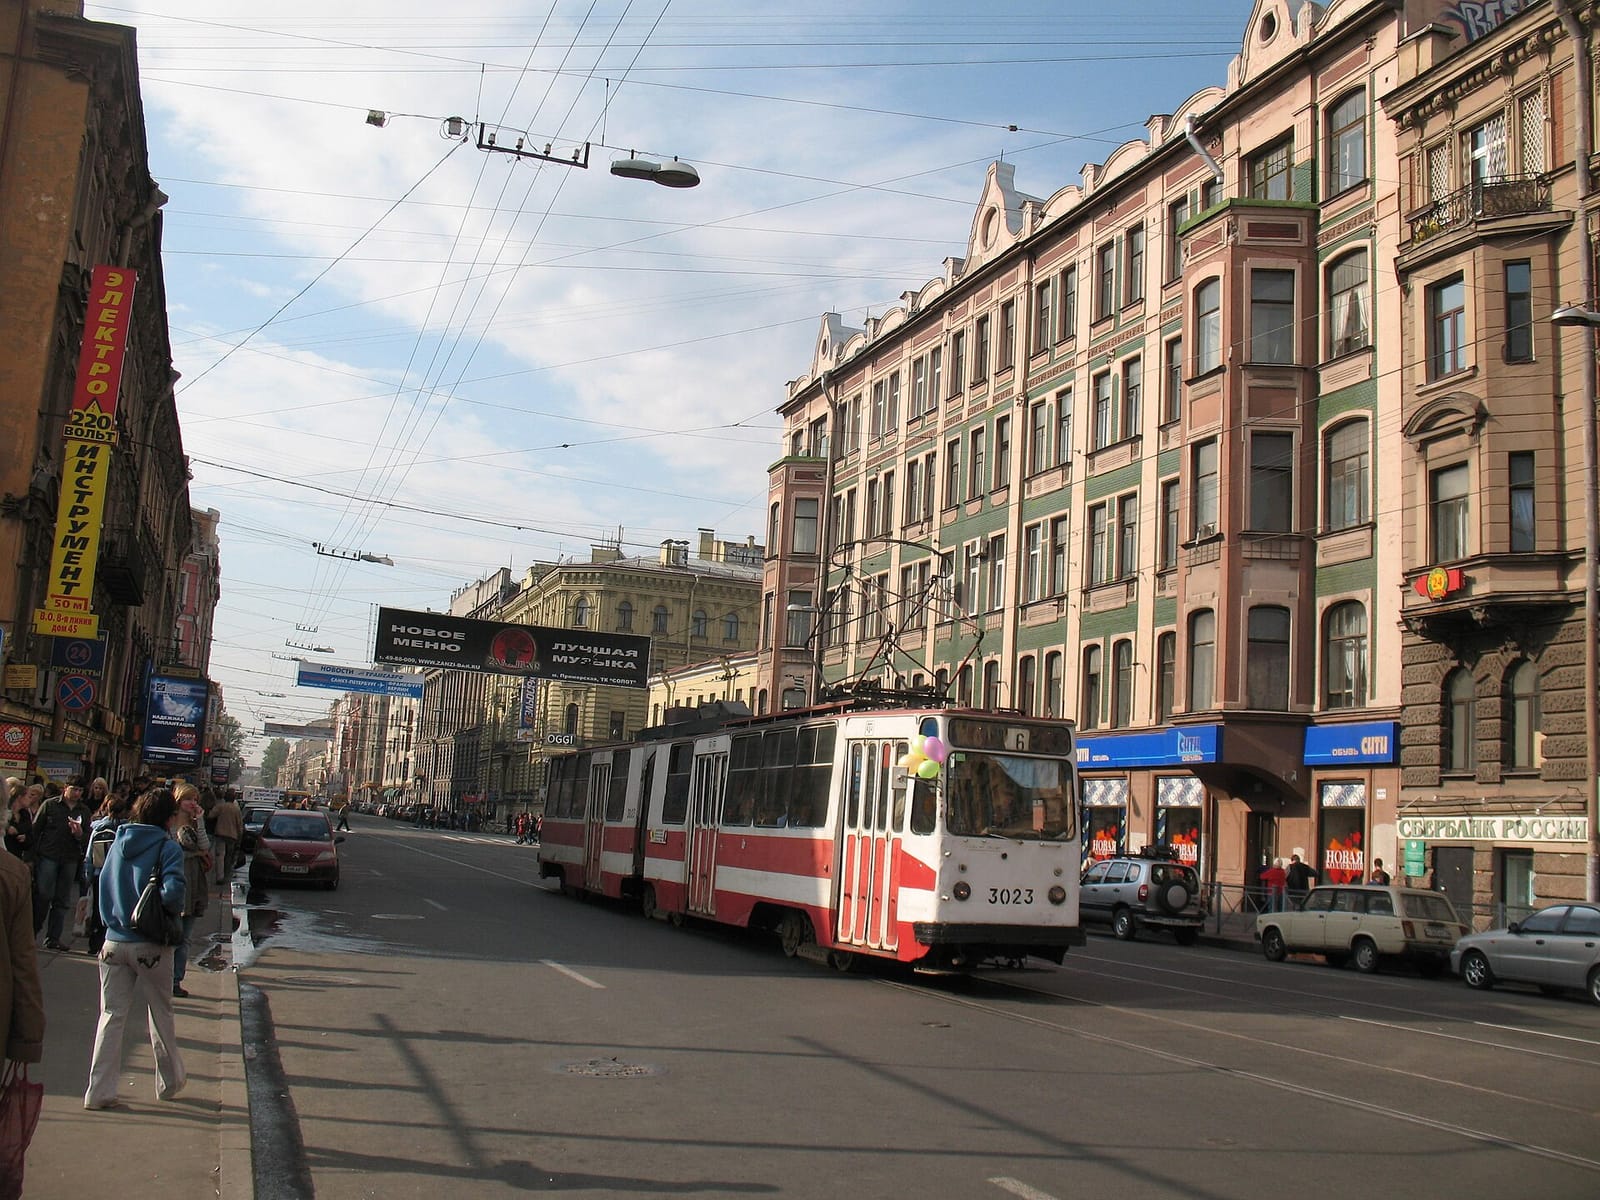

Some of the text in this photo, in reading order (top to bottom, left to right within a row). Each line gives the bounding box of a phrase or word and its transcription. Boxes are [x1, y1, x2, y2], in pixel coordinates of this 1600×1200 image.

[86, 272, 124, 395] ЭЛЕКТРО
[71, 411, 112, 430] 220
[64, 426, 116, 442] ВОЛЬТ
[60, 444, 101, 596] ИНСТРУМЕНТ
[54, 599, 70, 608] 50
[39, 611, 92, 626] В.О. 8-я линия
[51, 624, 78, 634] дом 45
[391, 624, 467, 641] НОВОЕ
[70, 646, 89, 660] 24
[392, 637, 462, 653] МЕНЮ
[551, 642, 638, 658] ЛУЧШАЯ
[320, 665, 354, 675] НОВОСТИ
[552, 654, 637, 670] МУЗЫКА
[52, 666, 102, 677] ПРОДУКТЫ
[547, 734, 574, 745] OGGI
[1015, 733, 1025, 751] 6
[1331, 736, 1388, 757] ОБУВЬ СИТИ
[1076, 748, 1090, 763] ИТИ
[1398, 819, 1587, 840] СБЕРБАНК РОССИИ
[1093, 839, 1117, 852] НОВАЯ
[1326, 849, 1364, 863] НОВАЯ
[988, 888, 1034, 905] 3023
